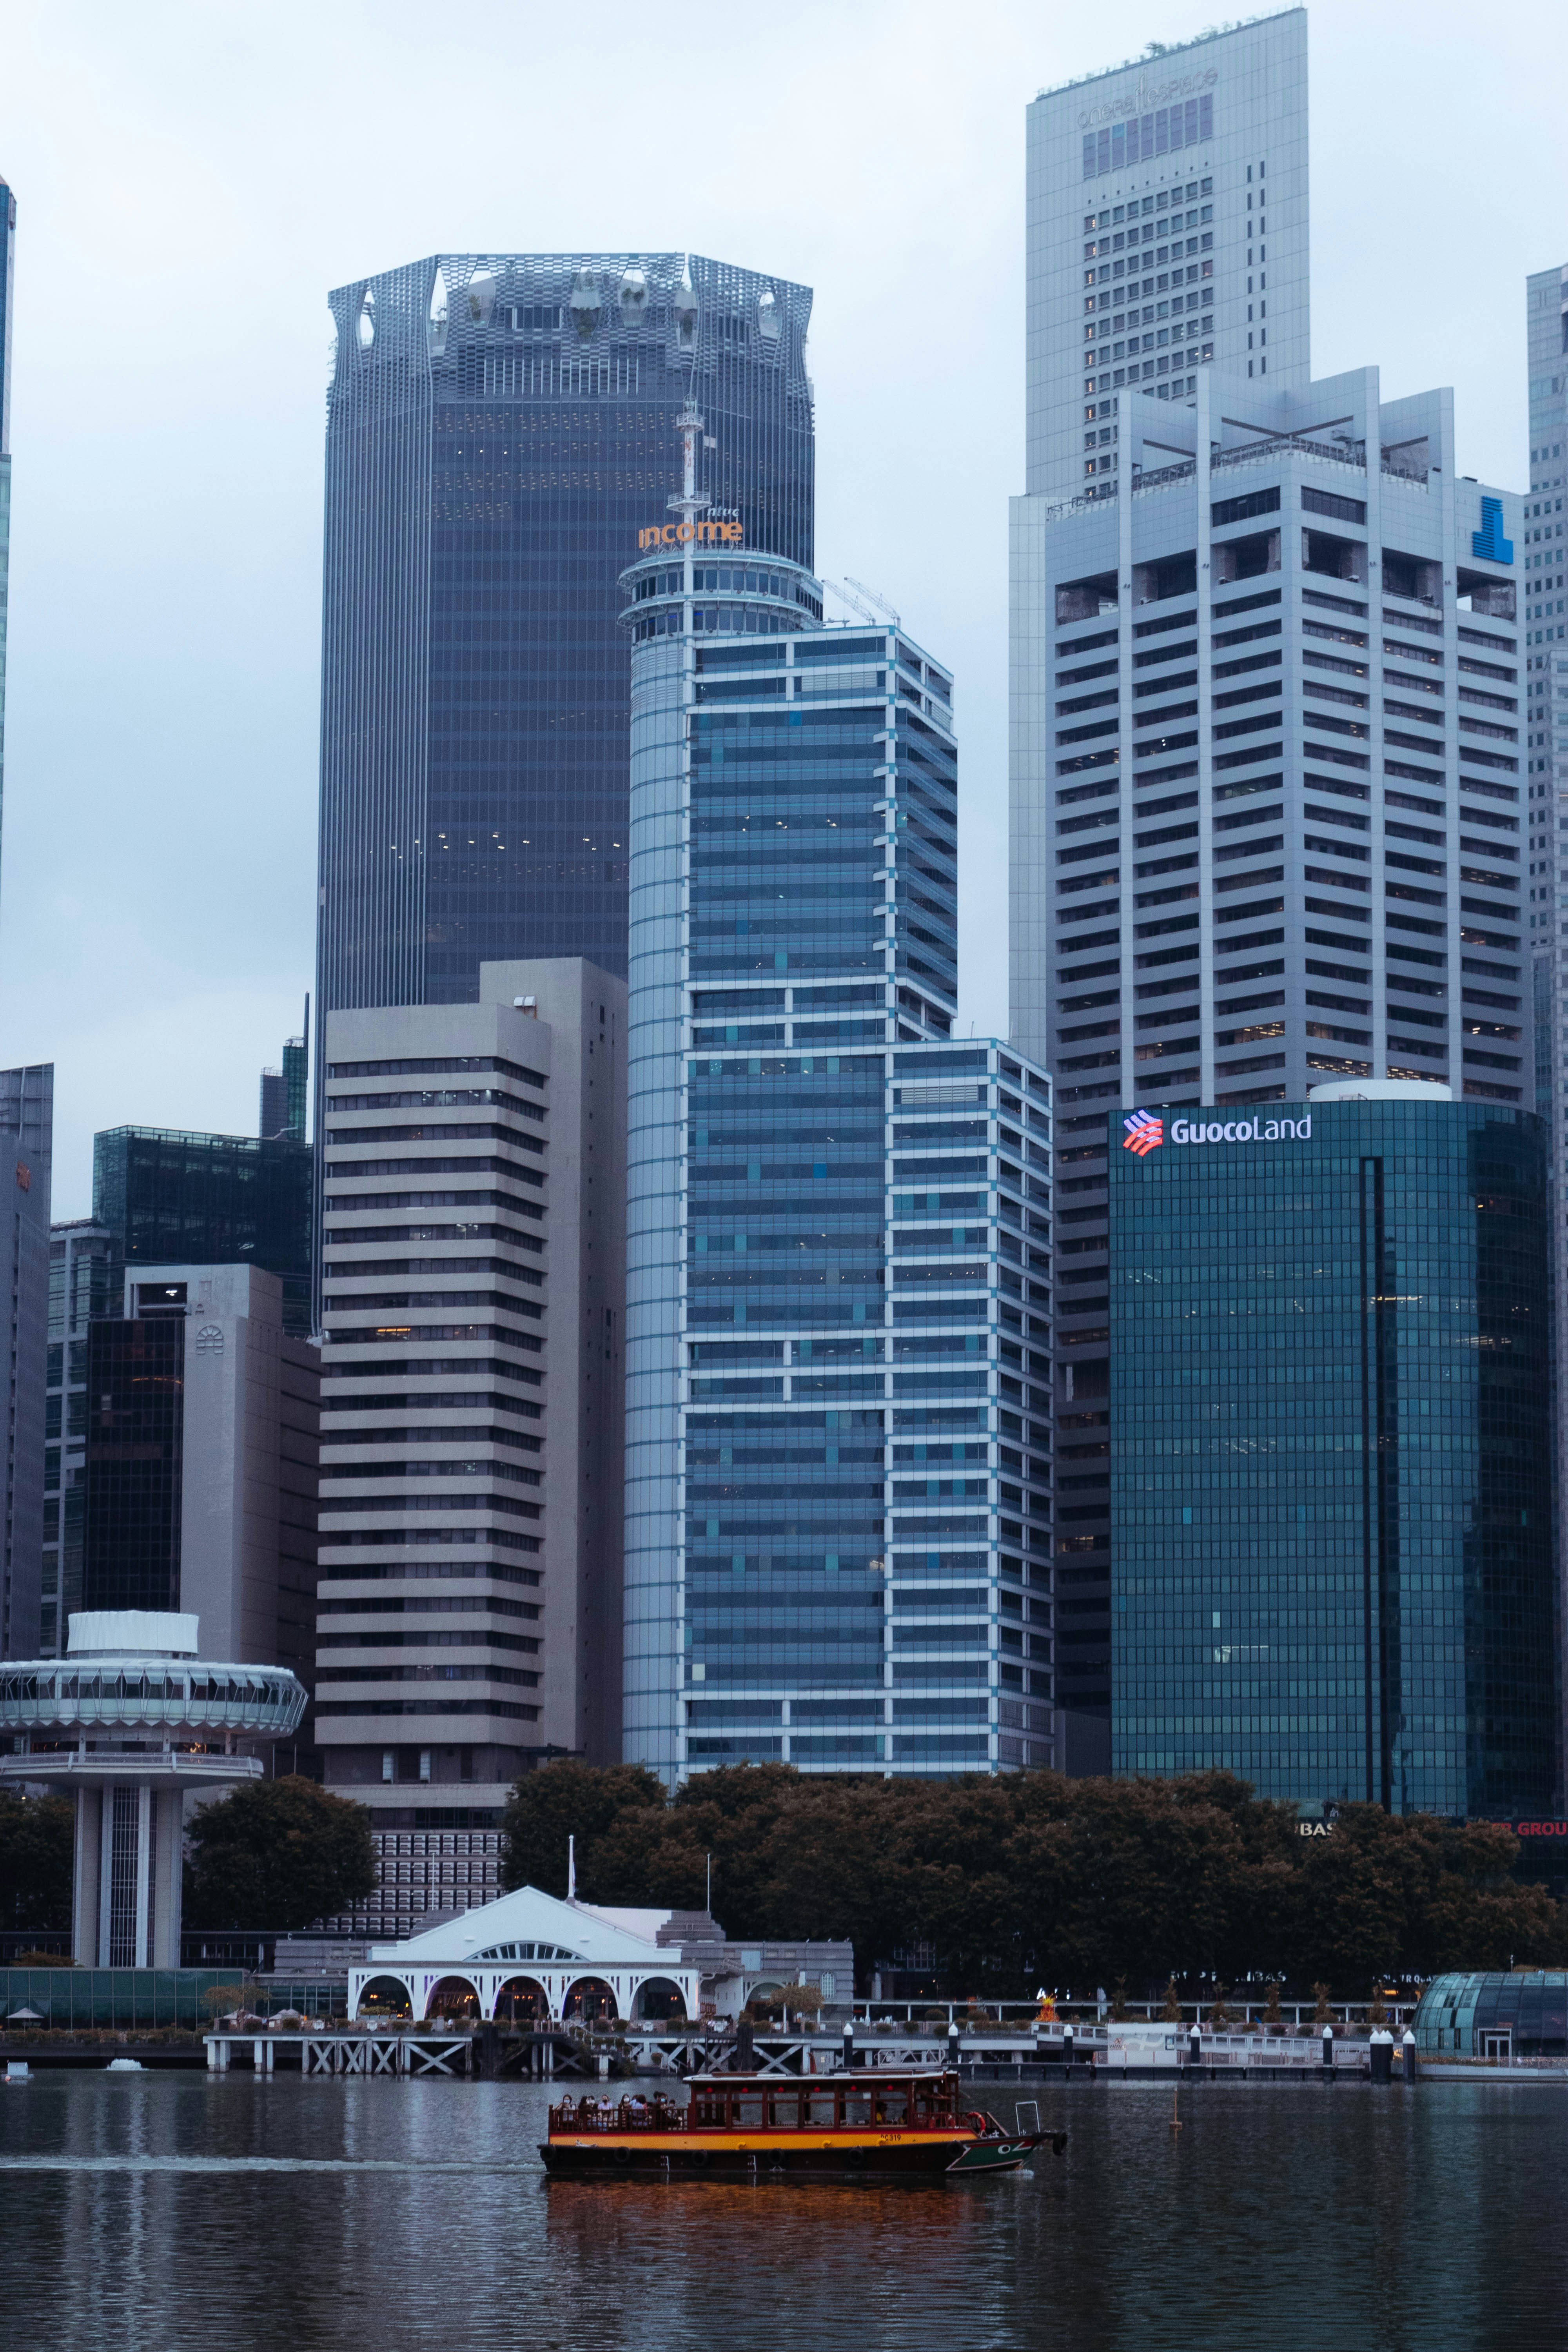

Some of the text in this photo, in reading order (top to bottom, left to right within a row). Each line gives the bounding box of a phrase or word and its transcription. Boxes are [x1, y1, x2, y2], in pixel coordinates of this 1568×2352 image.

[639, 521, 743, 548] income
[1171, 1114, 1312, 1143] GuocoLand
[1517, 1822, 1568, 1836] GROU
